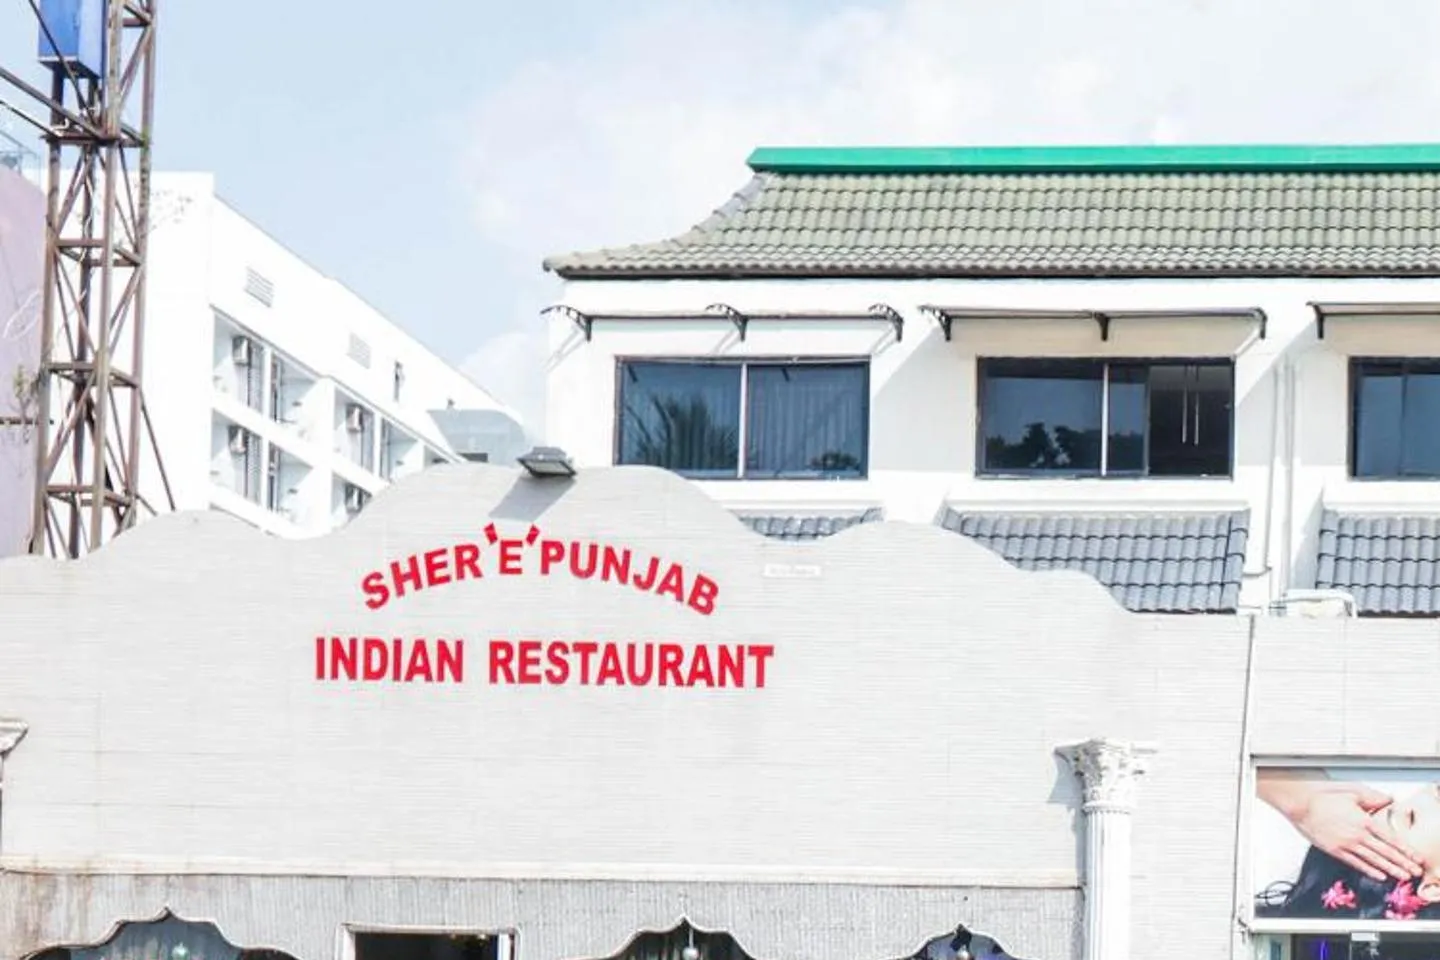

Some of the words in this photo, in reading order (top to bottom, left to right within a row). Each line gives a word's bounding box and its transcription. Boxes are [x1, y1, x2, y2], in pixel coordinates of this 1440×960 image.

[361, 543, 482, 610] SHER
[540, 540, 720, 616] PUNJAB
[315, 637, 464, 683] INDIAN
[489, 640, 775, 688] RESTAURANT
